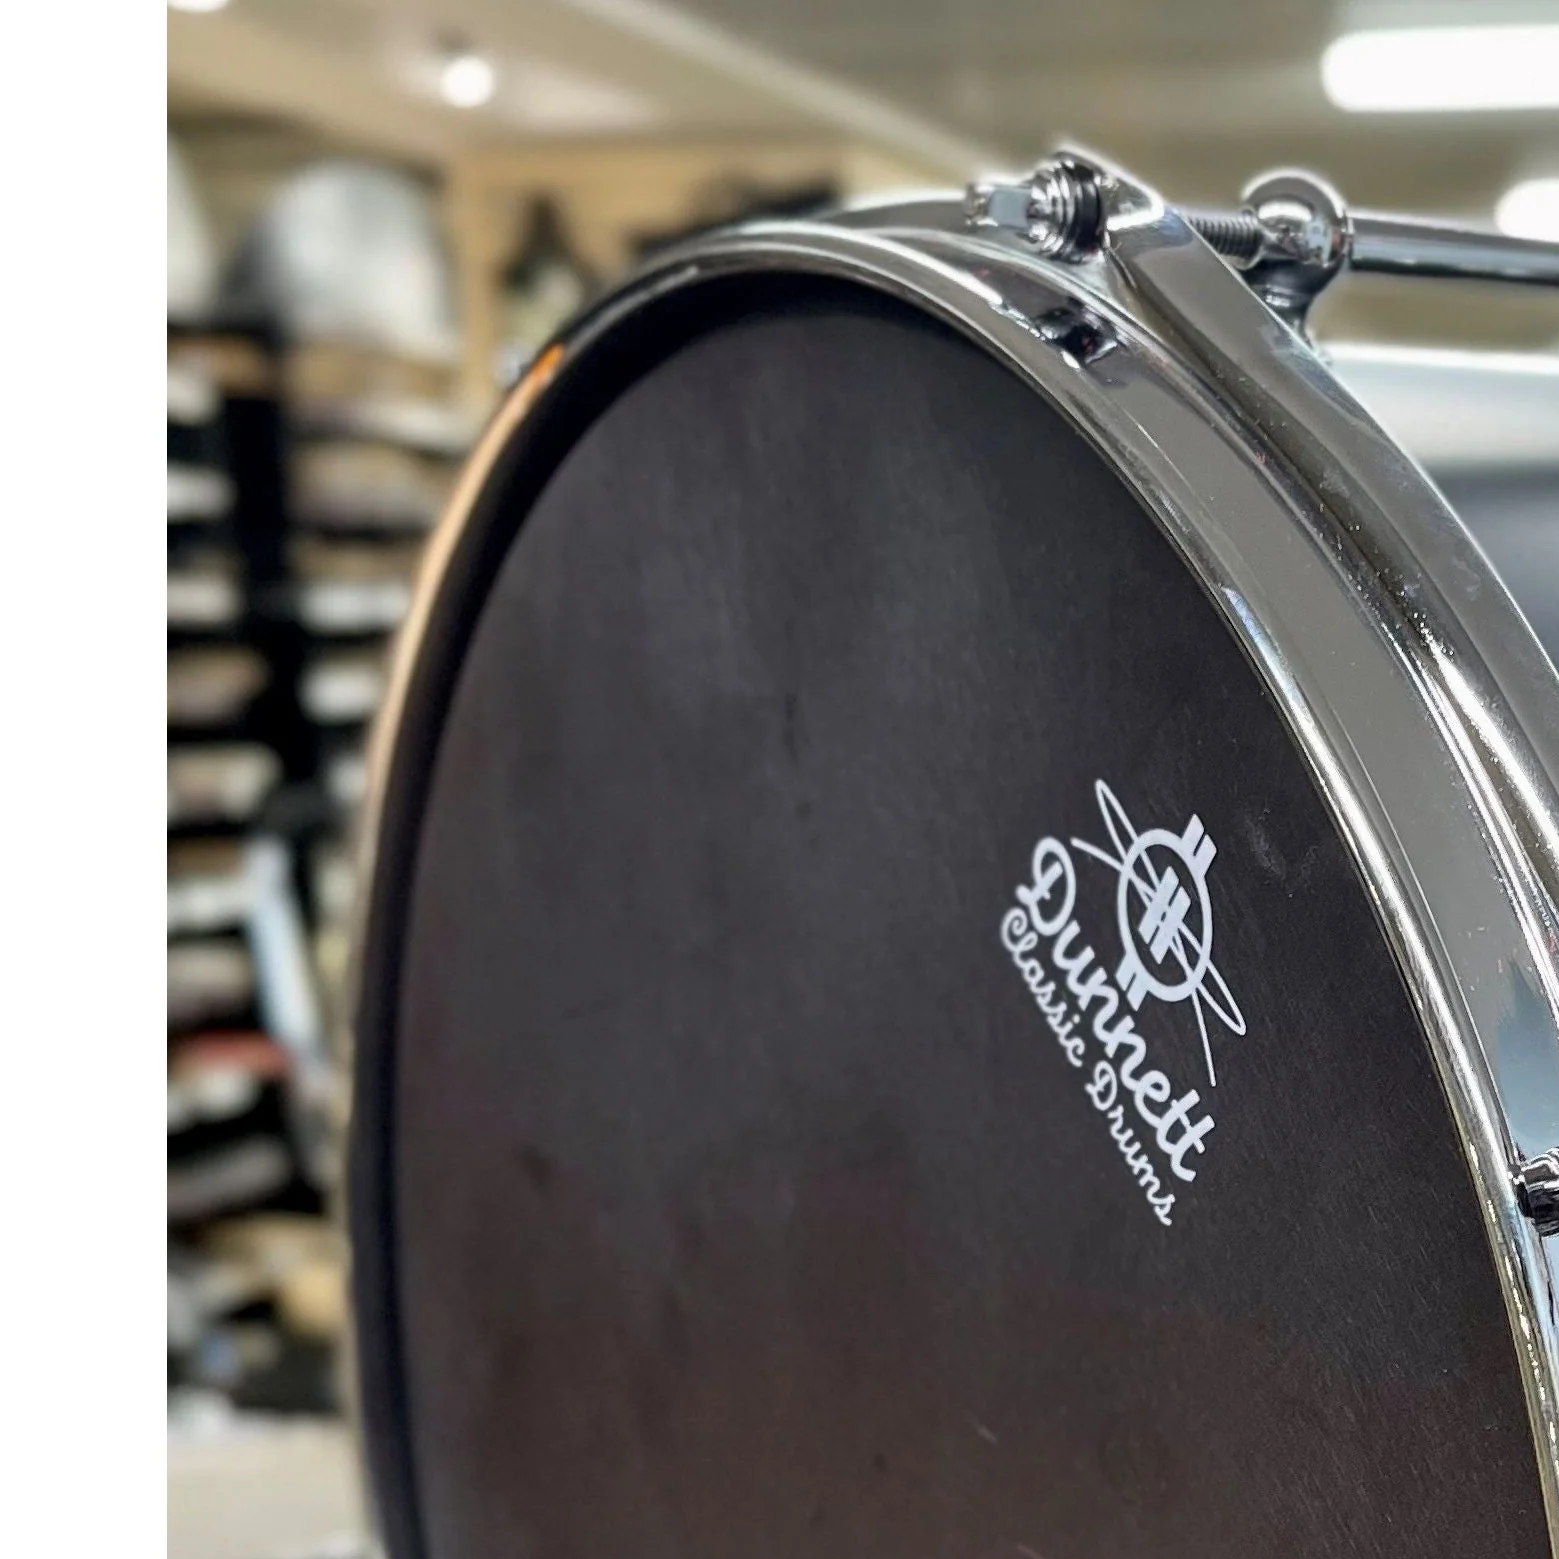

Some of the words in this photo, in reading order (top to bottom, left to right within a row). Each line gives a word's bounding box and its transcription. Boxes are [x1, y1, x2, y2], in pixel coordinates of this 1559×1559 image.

[1000, 907, 1086, 1067] Classic
[1085, 1060, 1176, 1226] Drums
[1015, 837, 1215, 1182] Dunnett
